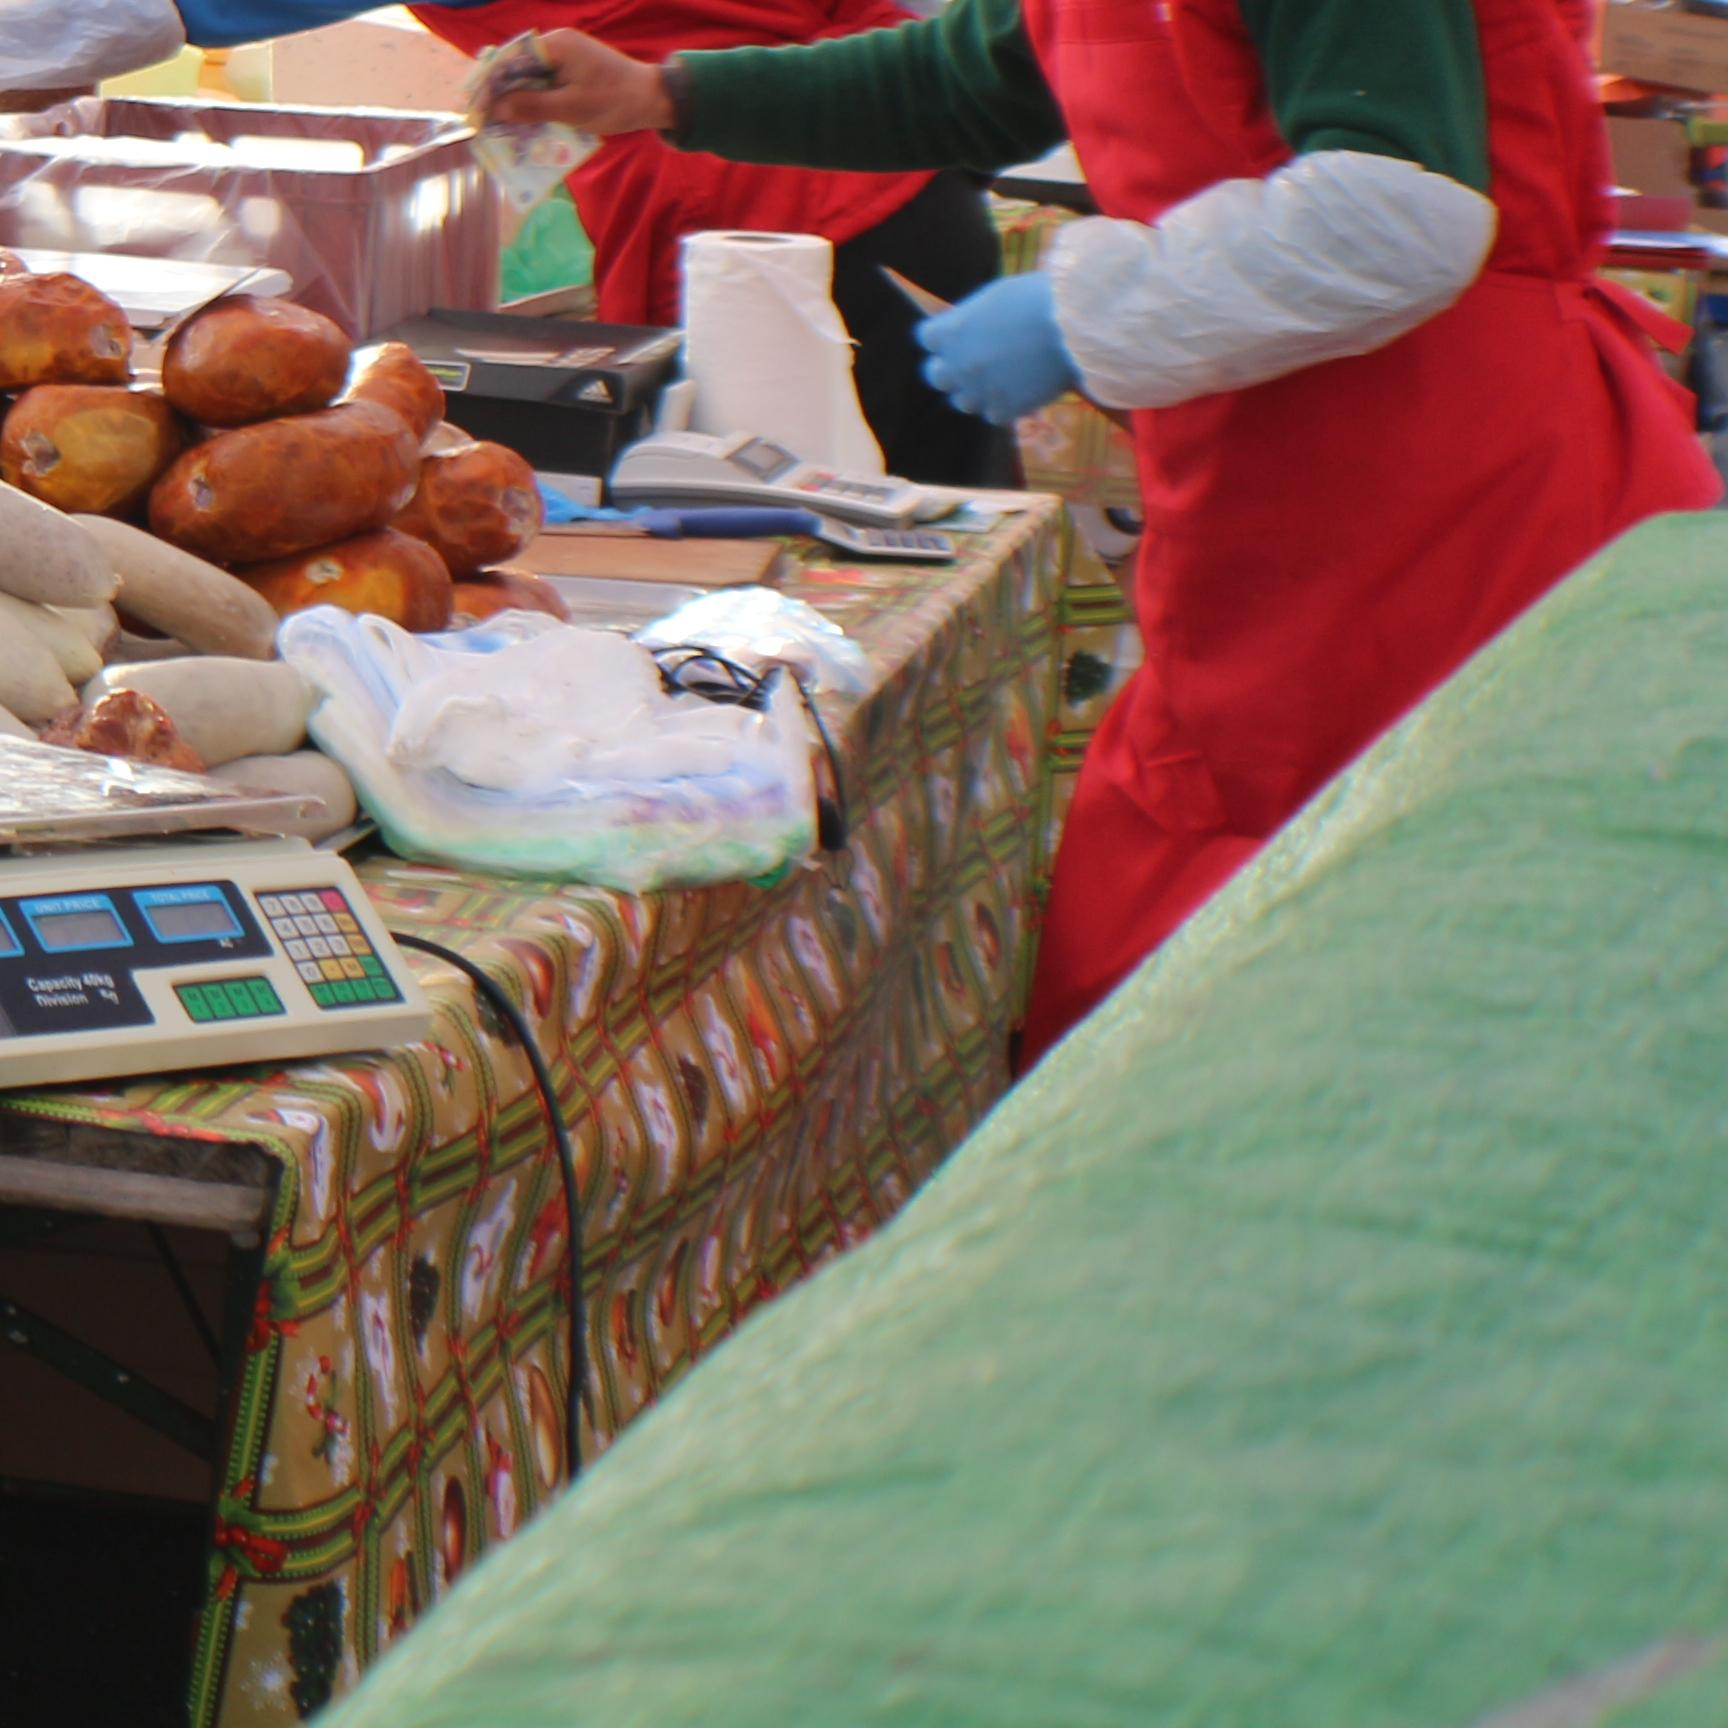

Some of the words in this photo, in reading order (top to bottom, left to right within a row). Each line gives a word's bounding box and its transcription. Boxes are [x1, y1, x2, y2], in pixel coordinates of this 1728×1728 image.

[181, 889, 211, 901] PRICE
[64, 898, 102, 912] PRICE
[28, 975, 83, 993] Capacity
[35, 992, 89, 1007] Division
